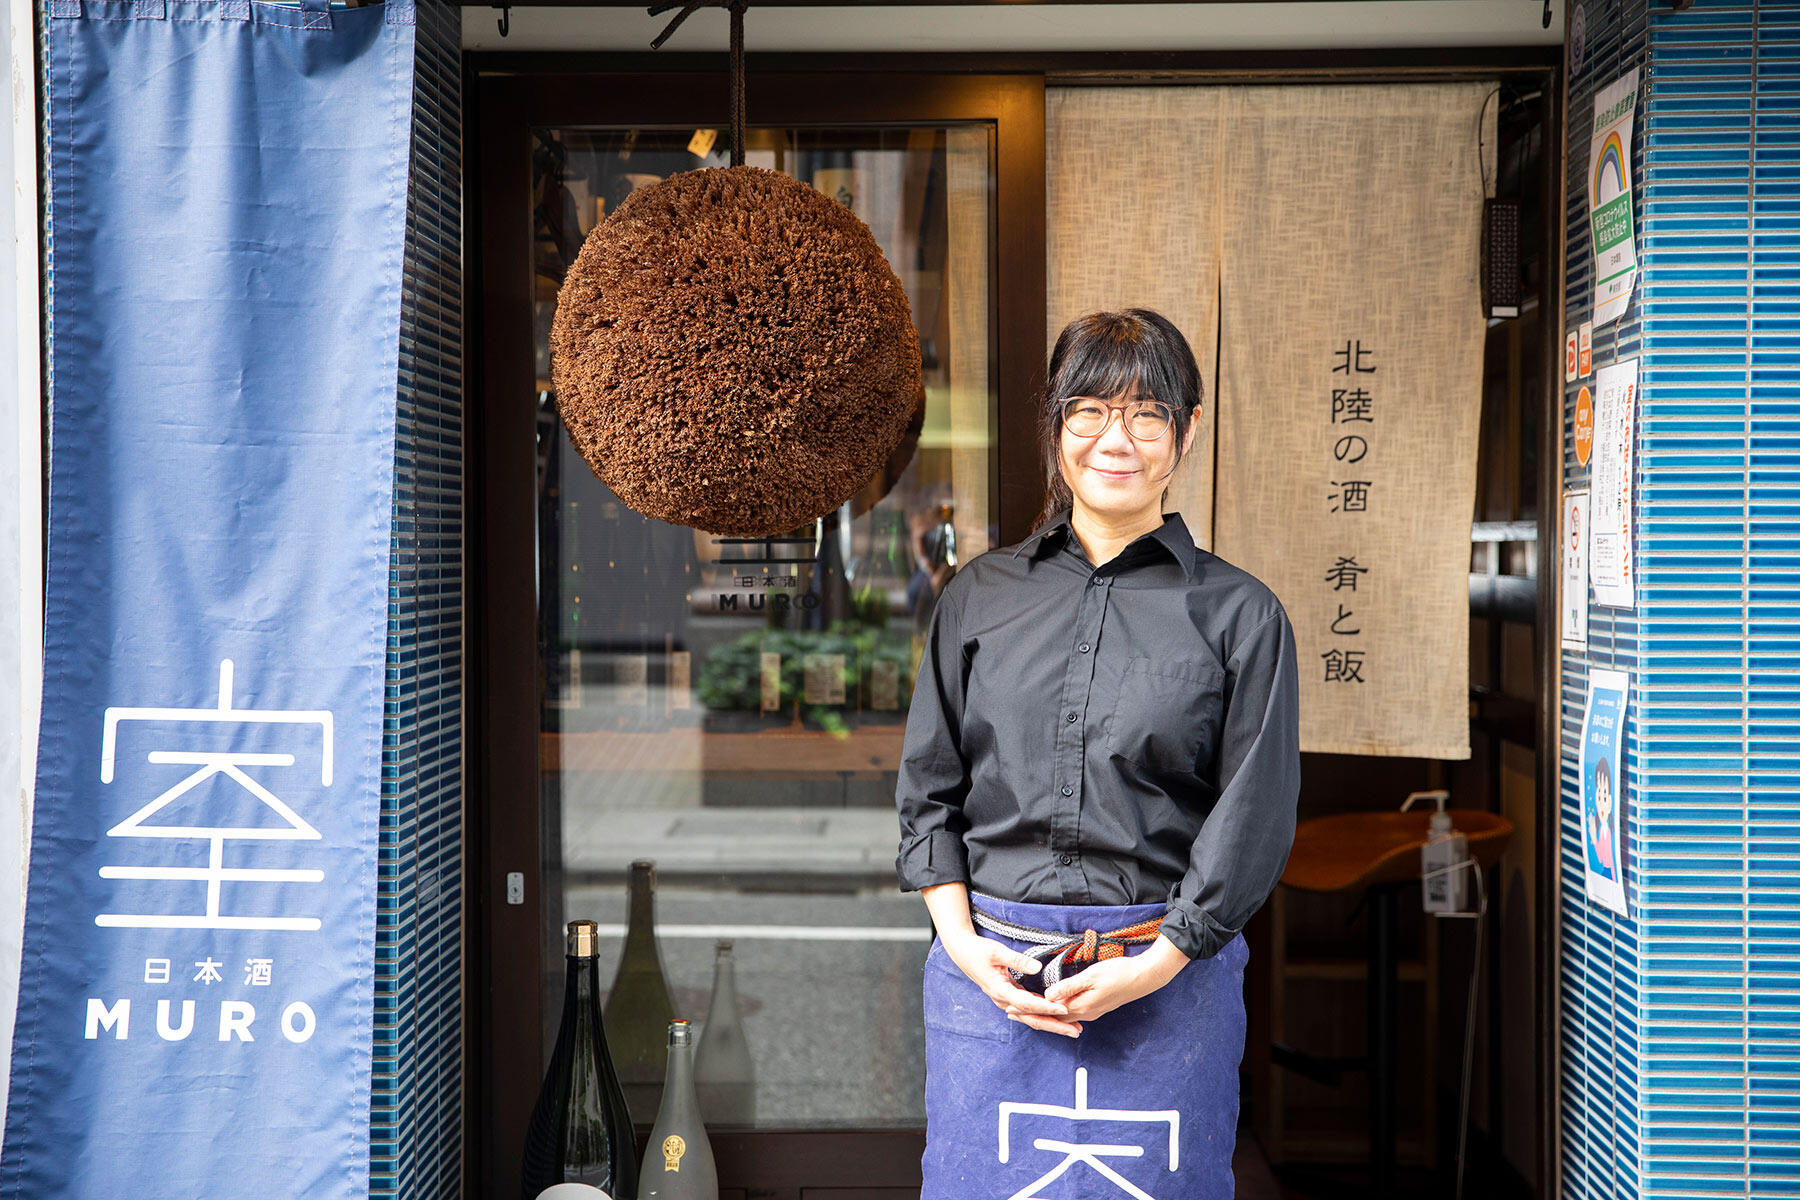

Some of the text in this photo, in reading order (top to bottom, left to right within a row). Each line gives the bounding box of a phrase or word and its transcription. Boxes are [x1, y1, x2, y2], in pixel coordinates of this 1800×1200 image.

[1320, 339, 1377, 684] 北陸の酒 肴と飯
[741, 575, 798, 588] 日本酒
[719, 594, 819, 611] MURO
[95, 658, 334, 931] 室
[144, 957, 274, 986] 日本酒
[84, 998, 317, 1043] MURO
